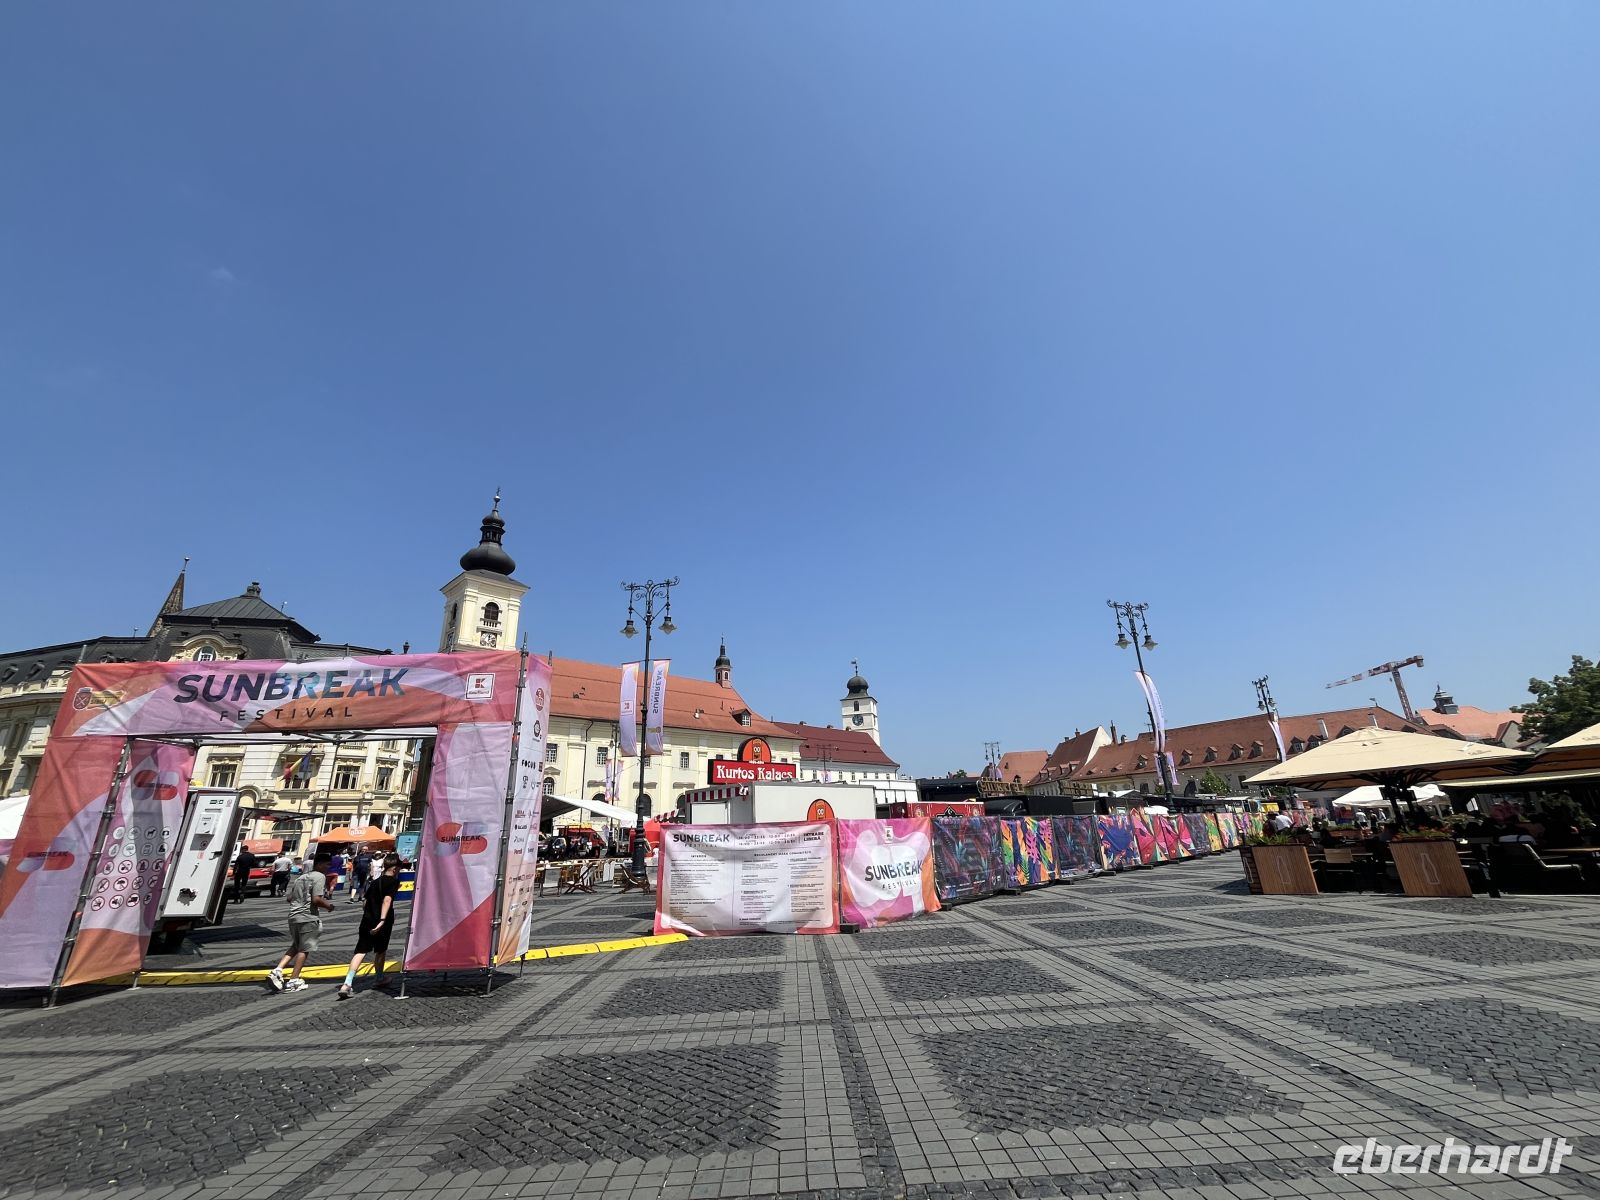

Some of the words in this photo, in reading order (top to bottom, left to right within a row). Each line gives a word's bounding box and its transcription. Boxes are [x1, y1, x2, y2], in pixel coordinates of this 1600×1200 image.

[173, 667, 409, 704] SUNBREAK
[219, 706, 353, 722] FESTIVAL
[521, 759, 537, 770] FOCUS
[716, 765, 755, 780] Kurtos
[757, 767, 793, 780] Kalacs
[440, 834, 482, 843] SUNBREAK
[672, 833, 730, 843] SUNBREAK
[864, 859, 923, 882] SUNBREAK
